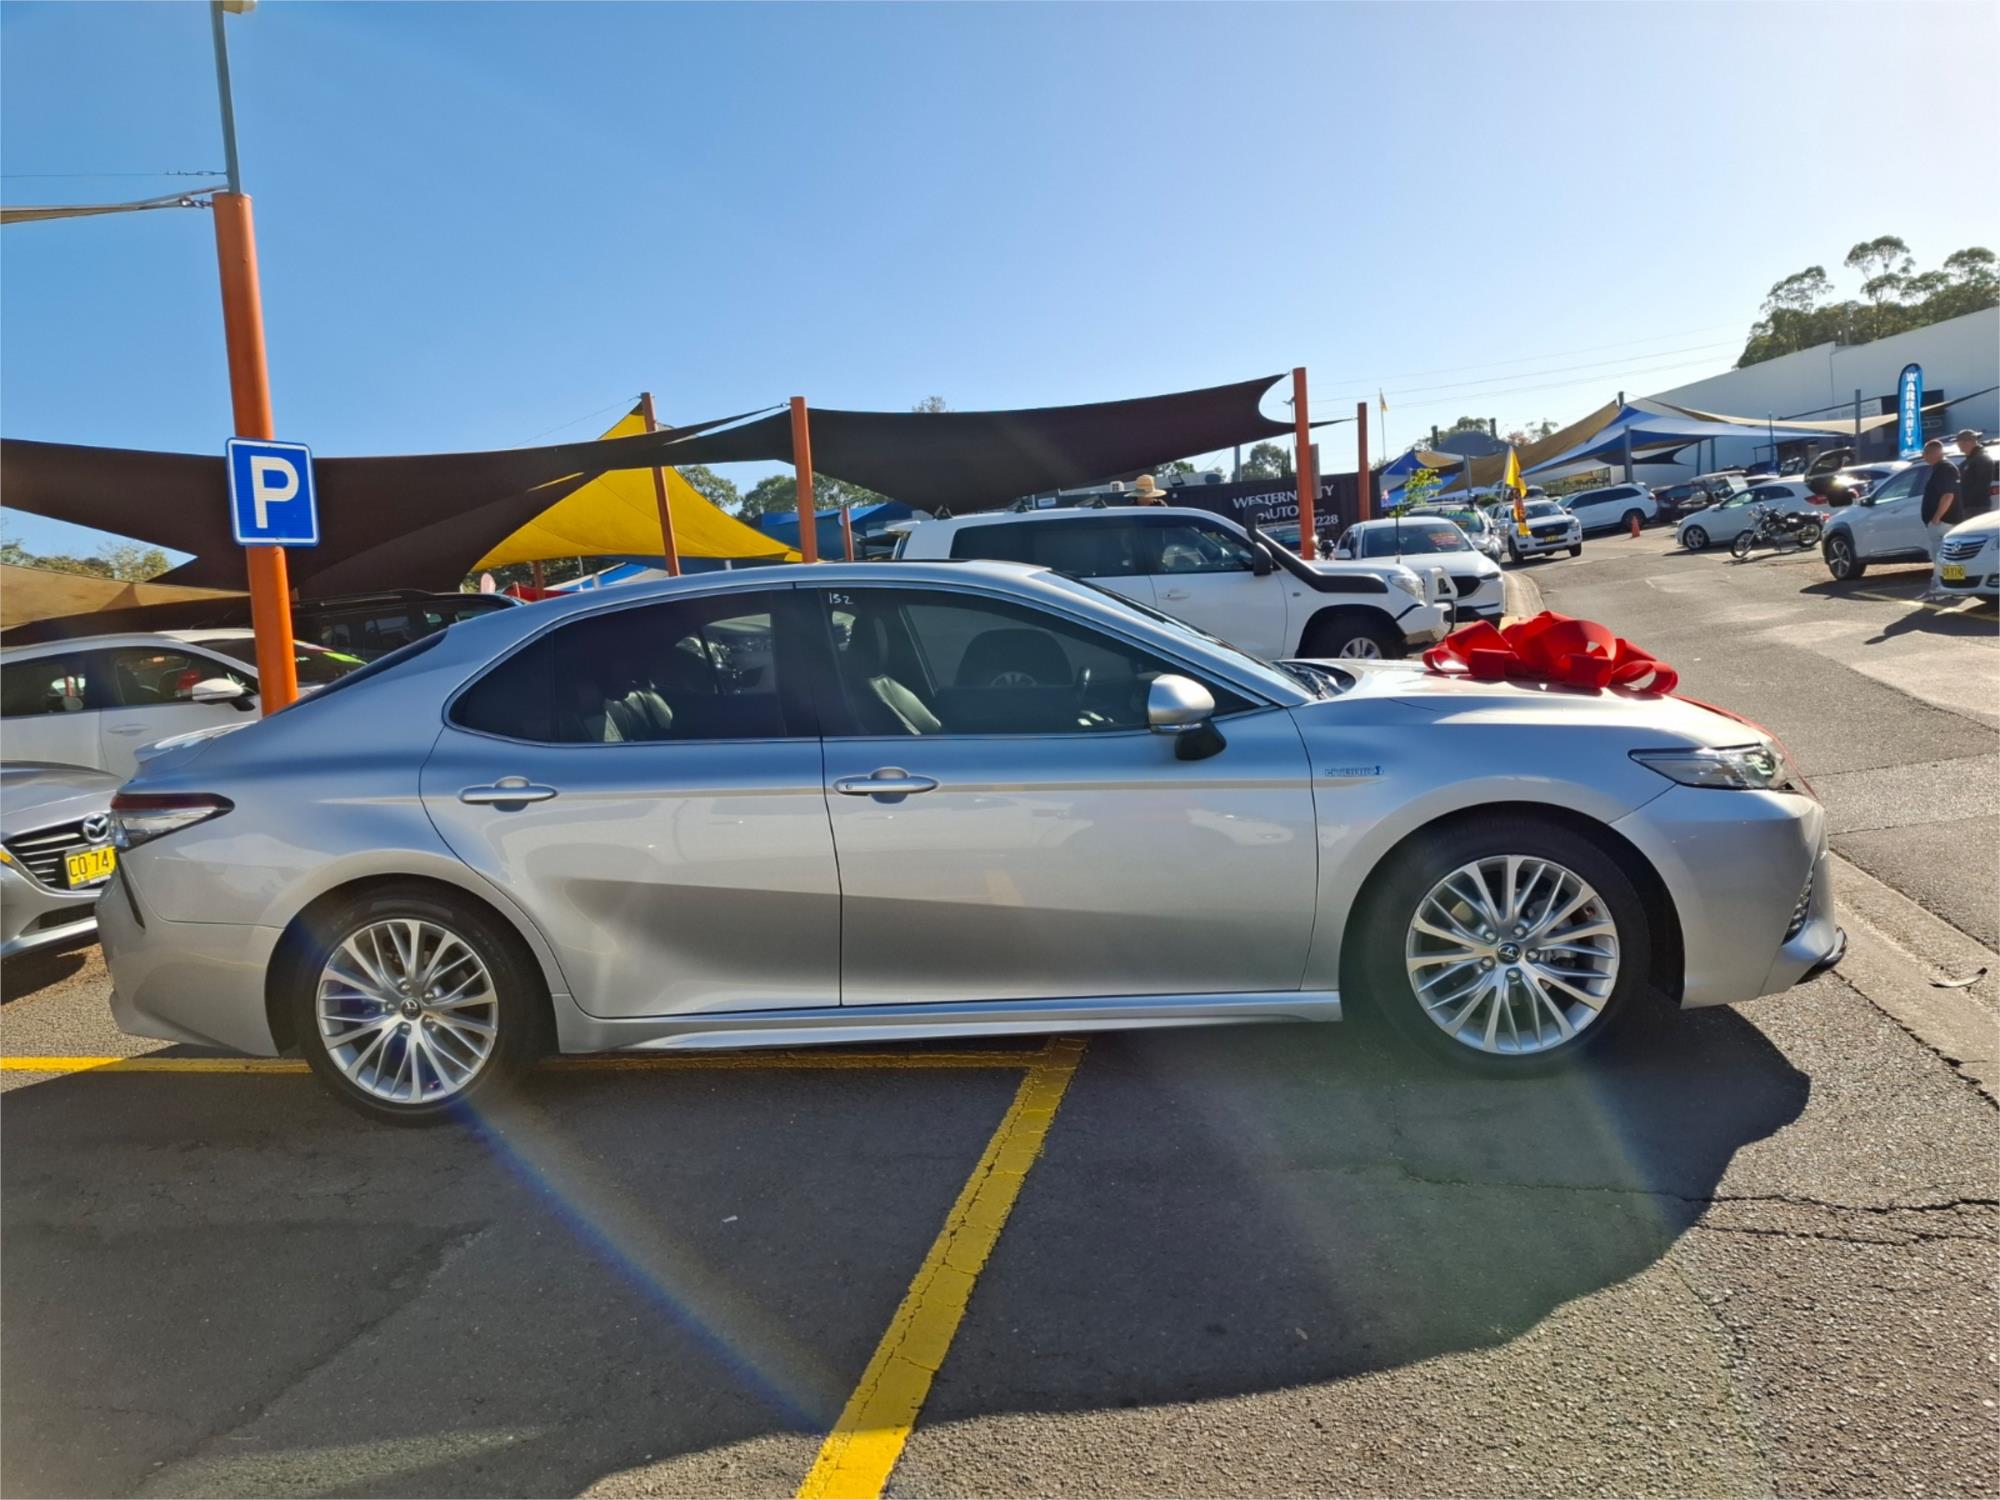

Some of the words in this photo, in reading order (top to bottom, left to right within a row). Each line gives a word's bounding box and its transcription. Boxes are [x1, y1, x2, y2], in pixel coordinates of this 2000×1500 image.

[1905, 372, 1918, 446] WARRANTY
[250, 455, 299, 529] P
[1232, 490, 1298, 509] WESTERN
[828, 591, 854, 605] 152
